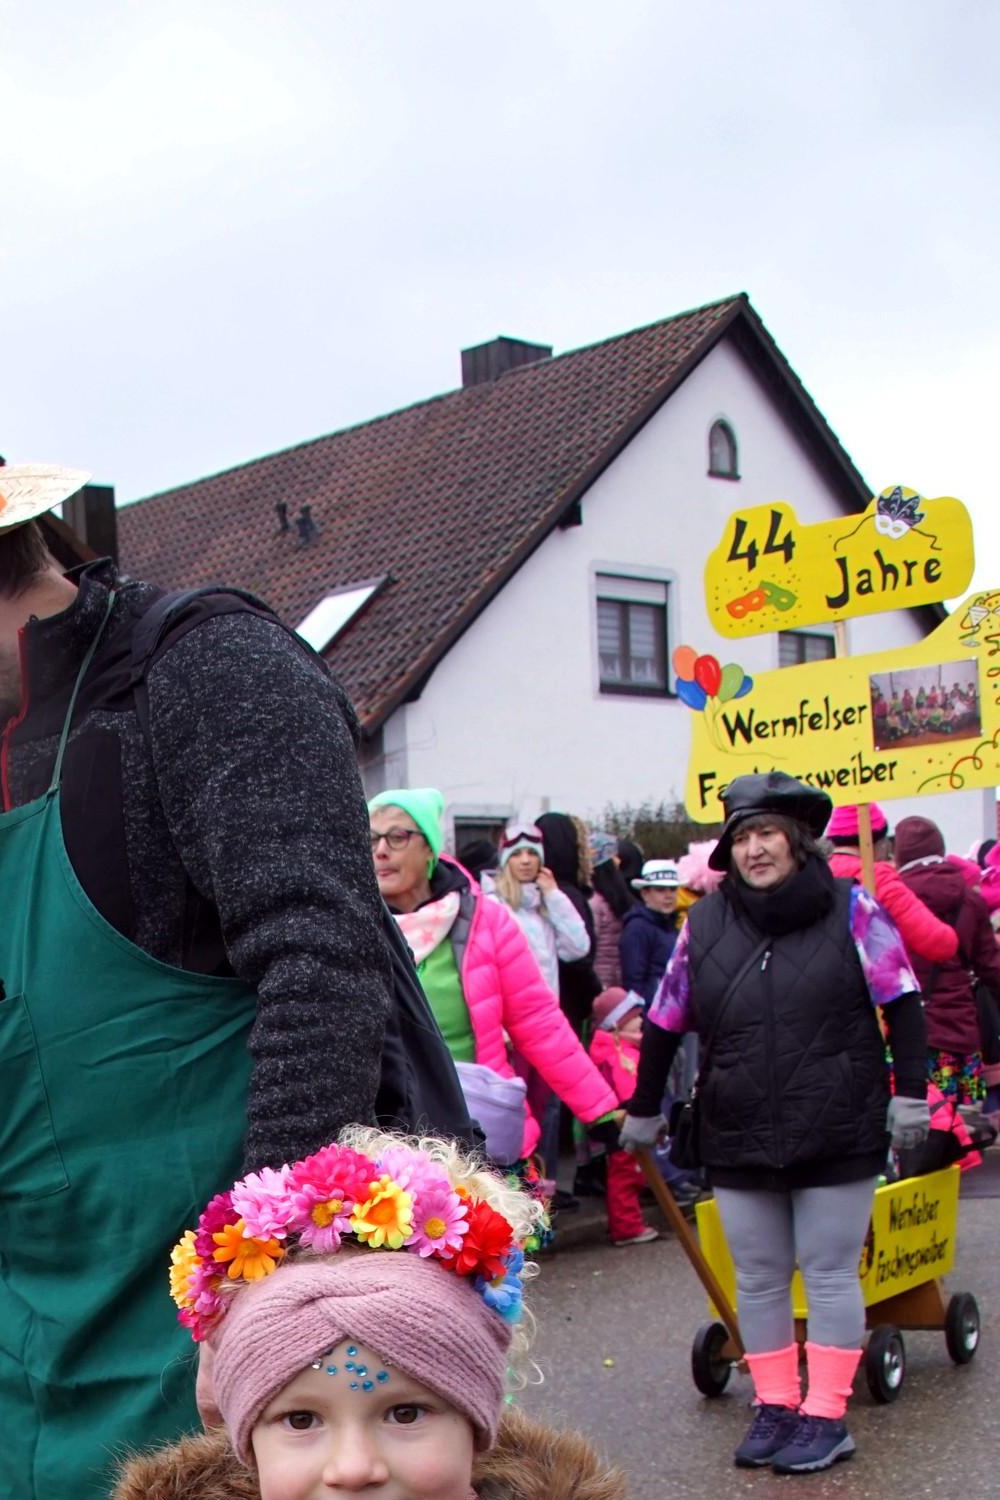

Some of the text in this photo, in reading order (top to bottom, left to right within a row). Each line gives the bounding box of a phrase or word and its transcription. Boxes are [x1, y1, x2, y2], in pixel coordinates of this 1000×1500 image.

[727, 509, 943, 609] 44 Jahre
[722, 696, 868, 746] Wernfelser
[889, 1191, 940, 1232] Wernfelser
